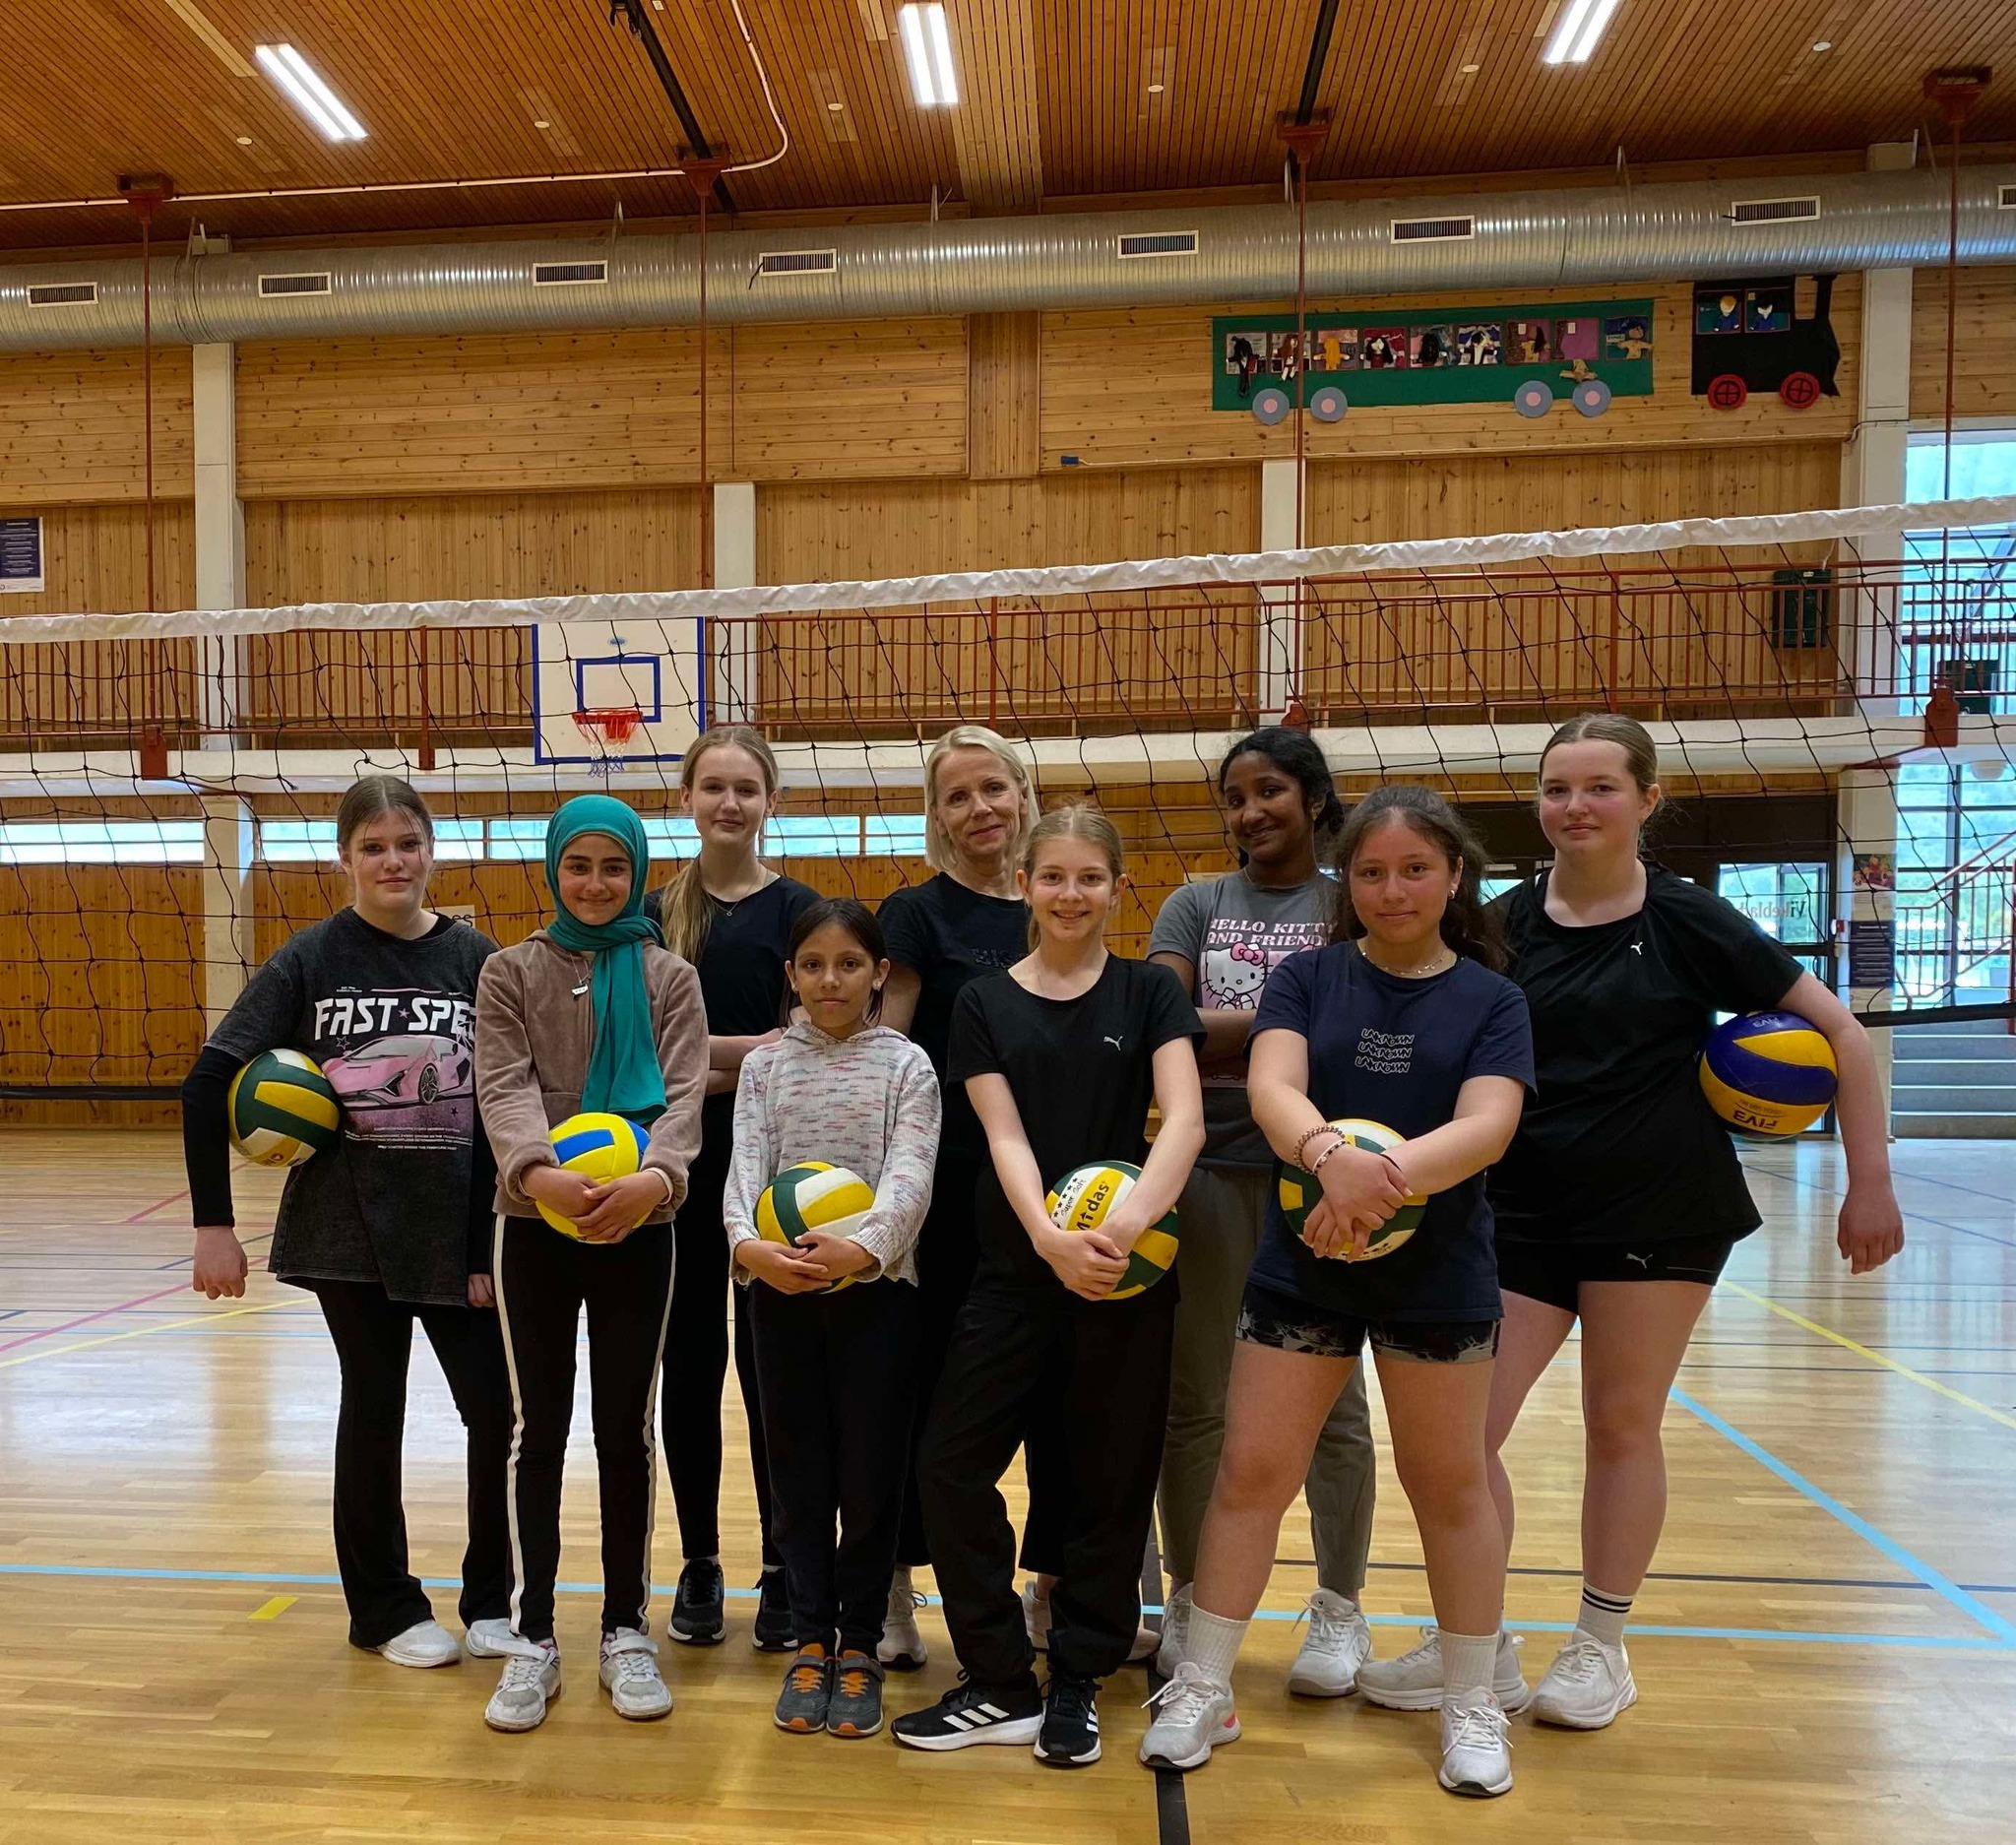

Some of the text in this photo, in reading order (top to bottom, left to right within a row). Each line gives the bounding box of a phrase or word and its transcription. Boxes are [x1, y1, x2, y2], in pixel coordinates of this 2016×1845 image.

[1207, 931, 1243, 944] AND
[314, 997, 399, 1041] FAST
[1361, 1028, 1415, 1047] UNKNOWN
[1357, 1041, 1413, 1060] UNKNOWN
[1354, 1055, 1411, 1074] UNKNOWN
